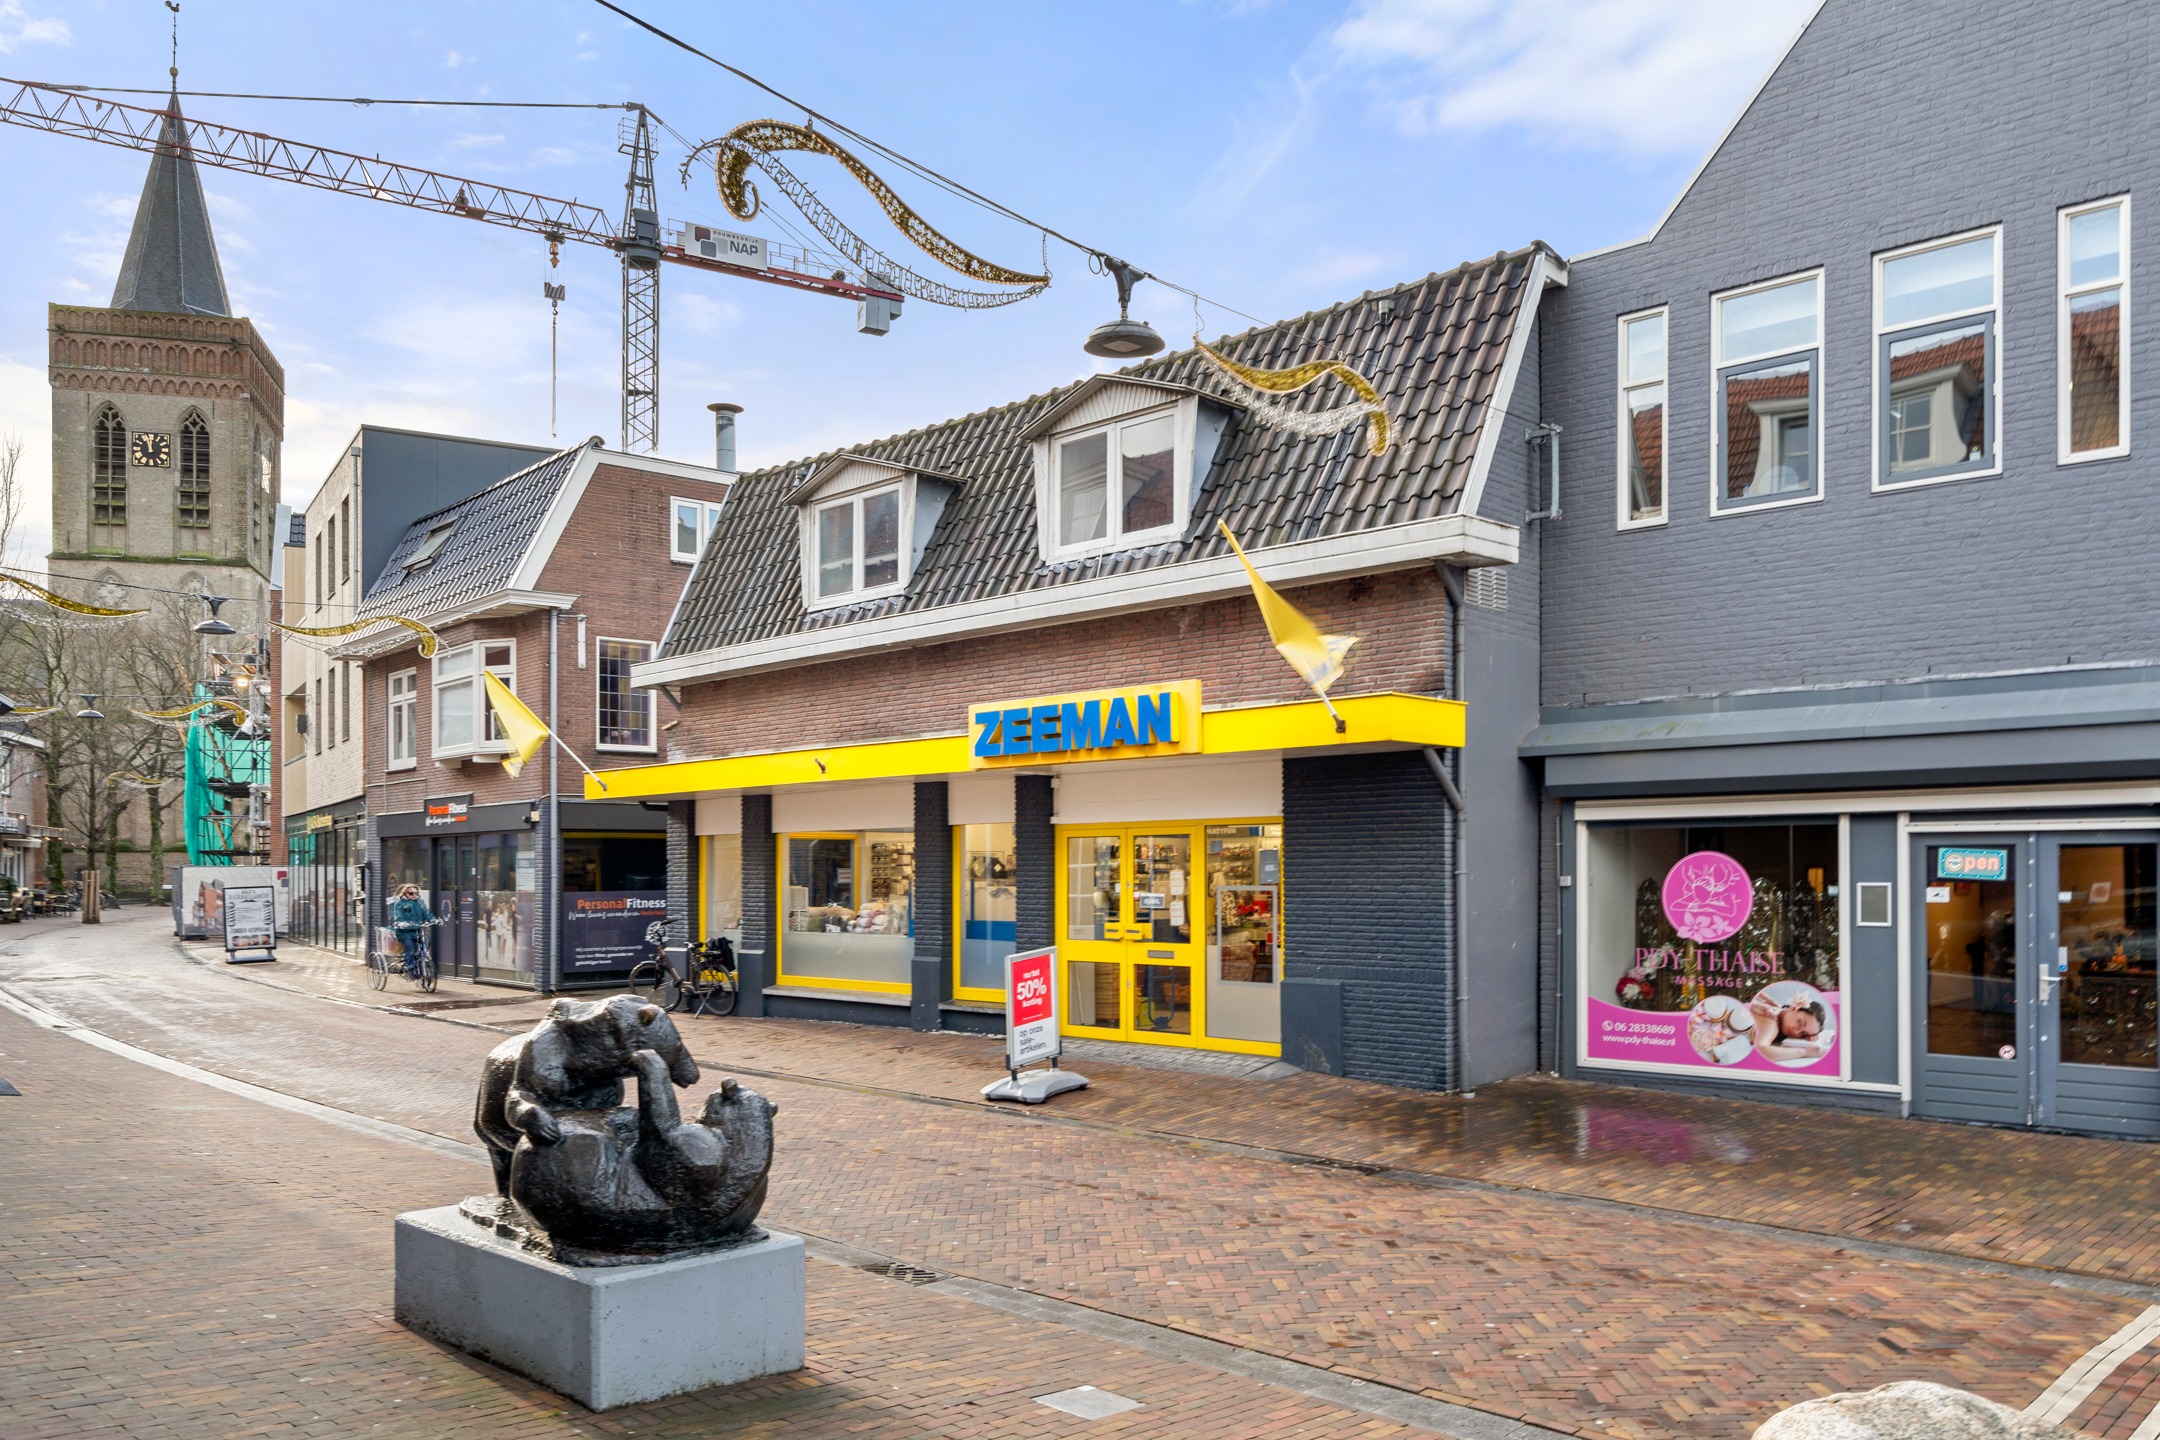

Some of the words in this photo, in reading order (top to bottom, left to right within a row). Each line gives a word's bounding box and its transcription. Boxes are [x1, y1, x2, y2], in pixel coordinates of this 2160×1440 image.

[713, 230, 758, 243] BOUWBEDRIJF
[729, 241, 758, 255] NAP
[974, 692, 1173, 758] ZEEMAN
[577, 898, 666, 909] PersonalFitness
[1635, 947, 1785, 974] PDY-THAISE
[1017, 977, 1047, 1000] 50%
[1675, 976, 1743, 988] MASSAGE
[1022, 997, 1042, 1007] korting
[1020, 1029, 1028, 1038] op
[1029, 1025, 1043, 1034] onze
[1614, 1021, 1627, 1032] 06
[1628, 1022, 1676, 1035] 28338689
[1019, 1037, 1035, 1046] sale-
[1020, 1041, 1047, 1055] artikelen.
